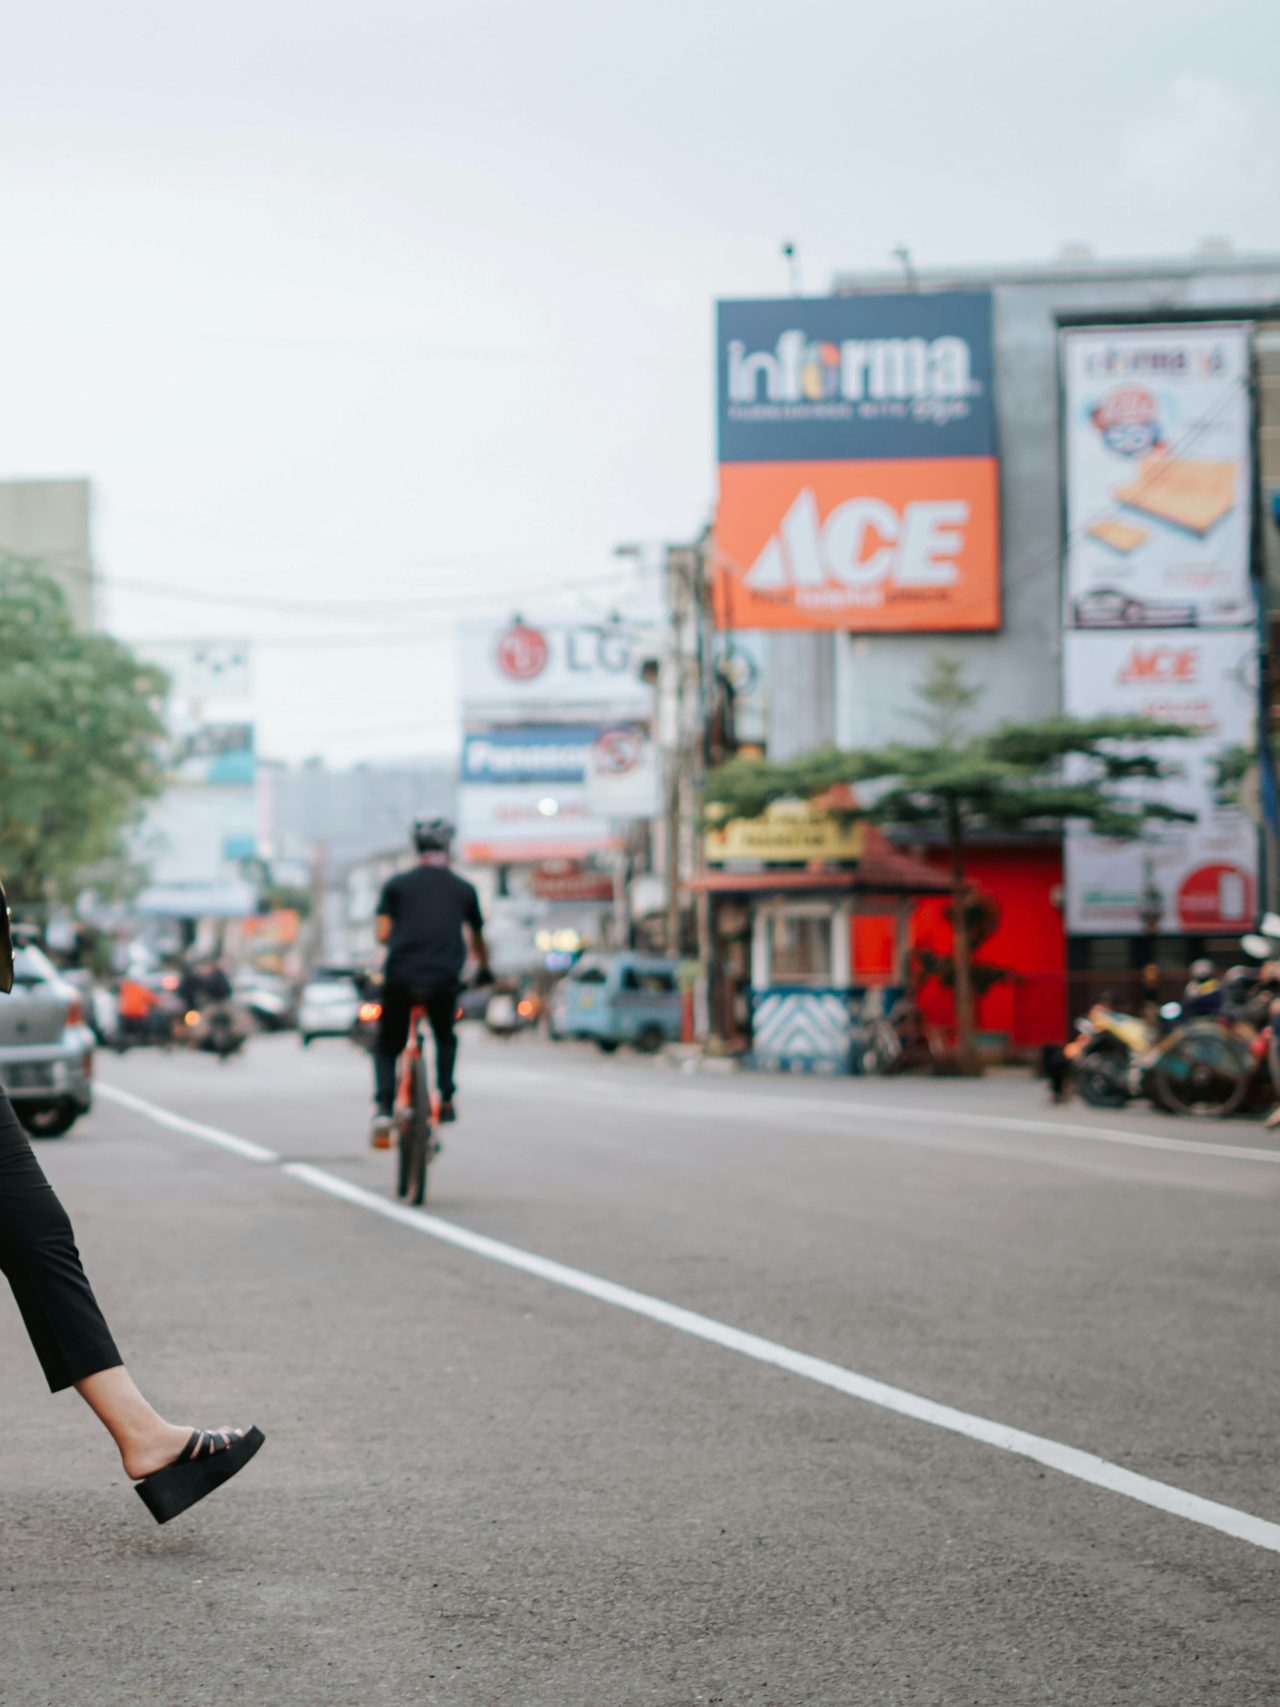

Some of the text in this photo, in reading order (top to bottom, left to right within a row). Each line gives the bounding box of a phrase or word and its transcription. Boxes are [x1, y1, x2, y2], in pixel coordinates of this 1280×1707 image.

[727, 328, 972, 401] informa
[742, 487, 970, 592] ACE
[567, 632, 631, 674] LG
[1118, 645, 1202, 683] ACE
